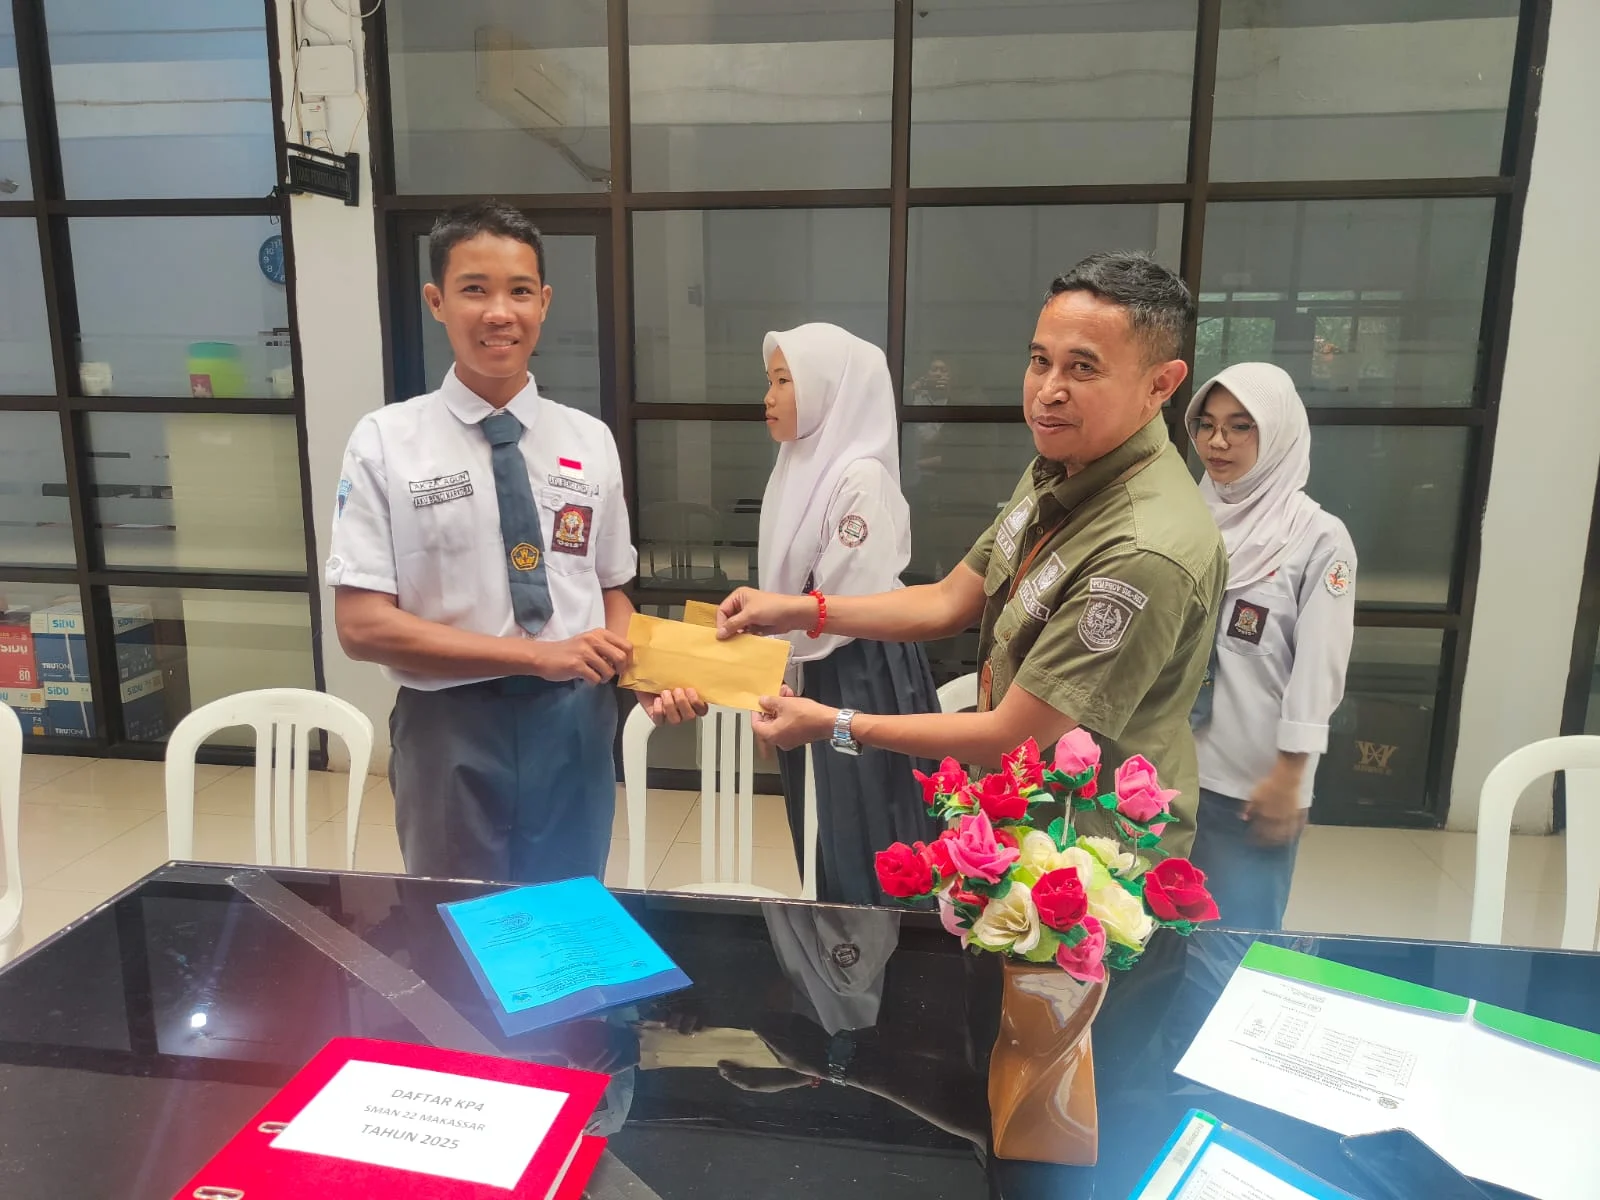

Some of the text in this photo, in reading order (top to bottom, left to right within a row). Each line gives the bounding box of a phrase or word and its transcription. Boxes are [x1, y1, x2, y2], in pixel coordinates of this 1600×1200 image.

[19, 669, 31, 681] 80
[391, 1089, 485, 1112] DAFTAR KP4
[363, 1104, 486, 1132] SMAN 22 MAKASSAR
[361, 1123, 461, 1150] TAHUN 2025
